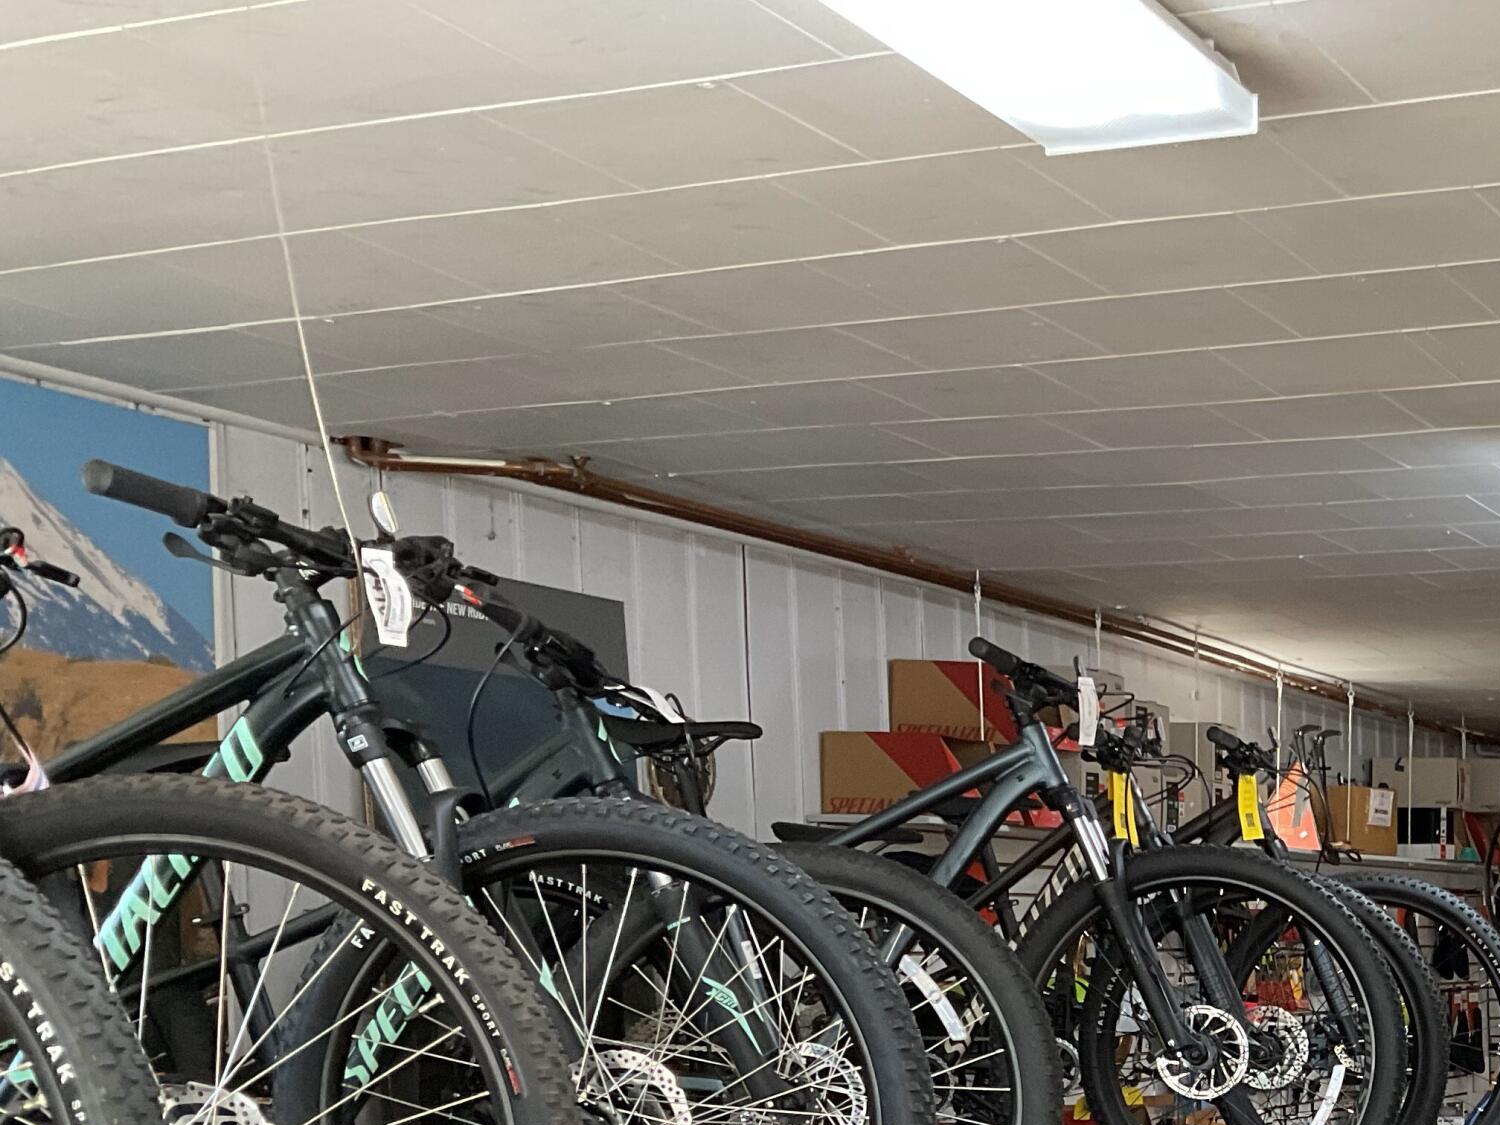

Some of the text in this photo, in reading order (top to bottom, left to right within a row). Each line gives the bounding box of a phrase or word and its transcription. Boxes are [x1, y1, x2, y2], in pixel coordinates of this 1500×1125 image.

[0, 961, 28, 997] ST
[26, 1002, 76, 1085] TRAK
[360, 876, 417, 926] FAST
[419, 925, 470, 985] TRAK
[471, 994, 500, 1039] SPORT
